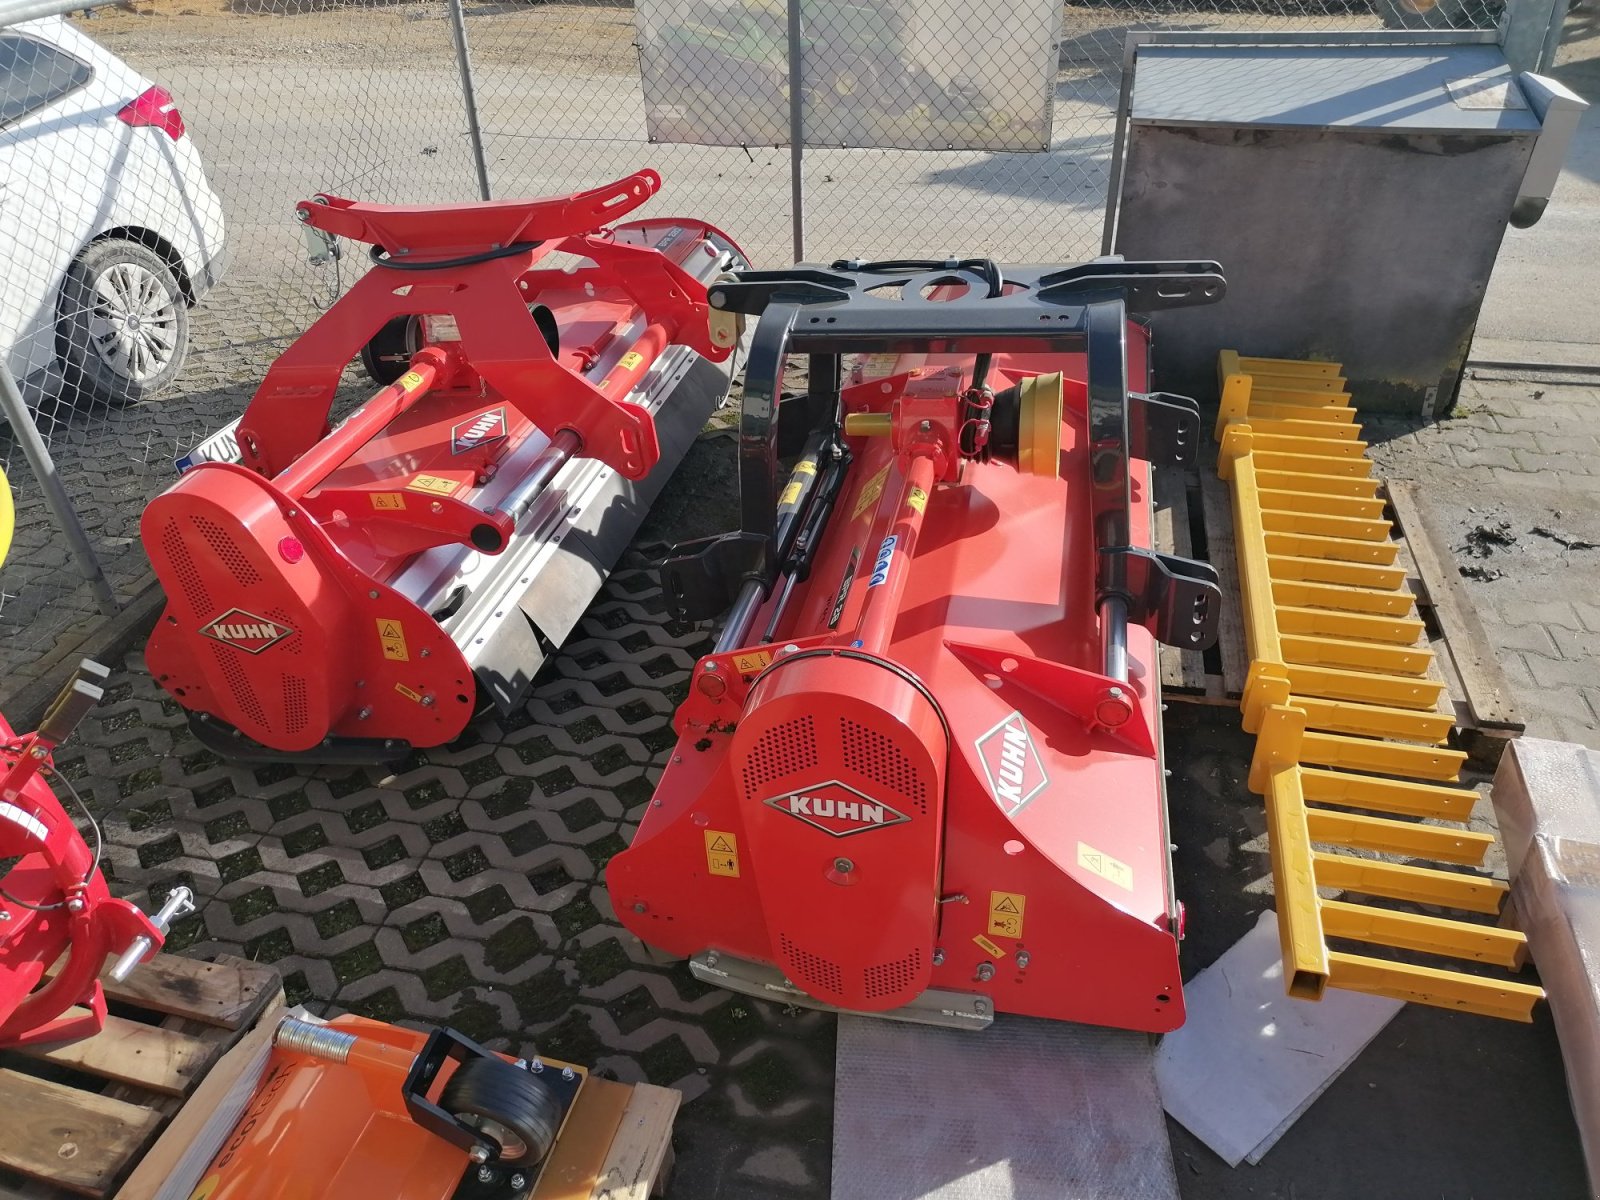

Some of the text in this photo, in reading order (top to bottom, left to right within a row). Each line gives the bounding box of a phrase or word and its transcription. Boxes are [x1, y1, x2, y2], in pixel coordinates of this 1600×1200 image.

[455, 413, 502, 448] KUHN
[212, 623, 279, 639] KUHN
[997, 723, 1027, 805] KUHN
[789, 795, 884, 824] KUHN
[218, 1061, 298, 1168] ecotech
